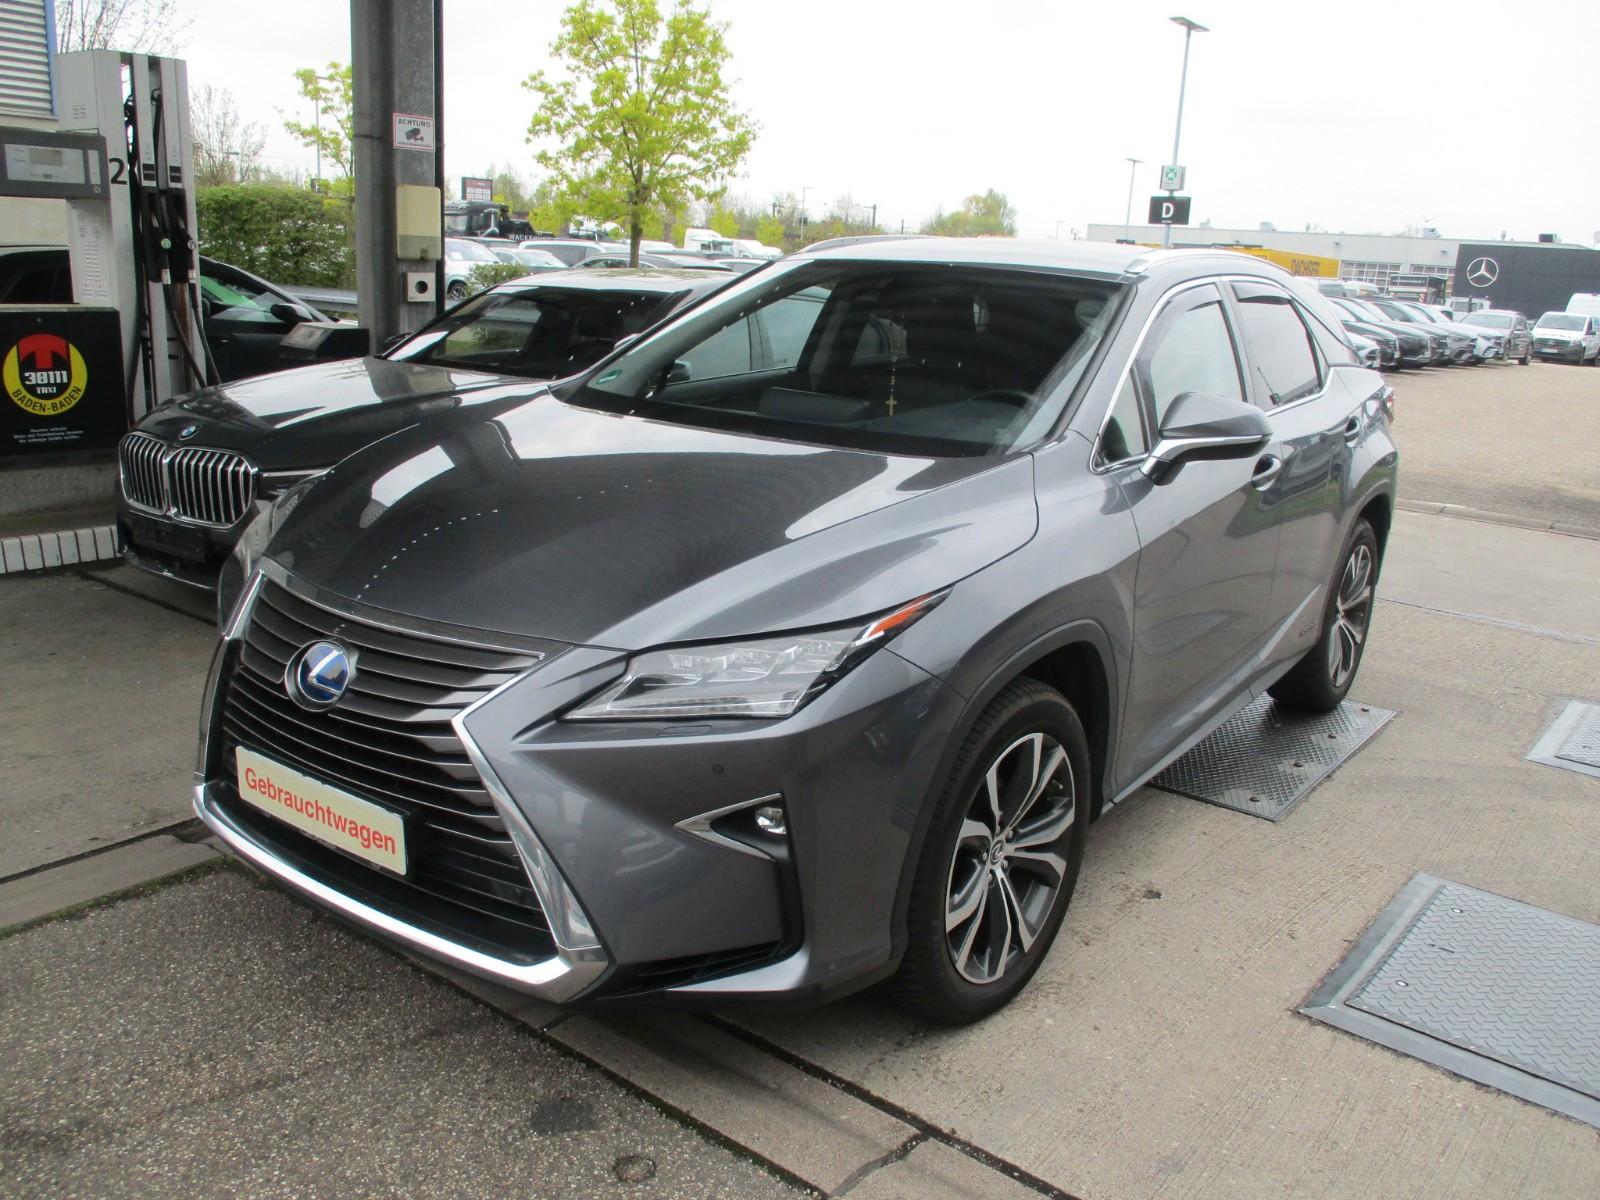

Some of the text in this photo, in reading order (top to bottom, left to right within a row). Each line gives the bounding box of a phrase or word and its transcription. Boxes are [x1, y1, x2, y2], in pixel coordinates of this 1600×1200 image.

[397, 117, 432, 128] ACHTUNG
[108, 157, 128, 186] 2
[1161, 202, 1174, 219] D
[24, 370, 68, 385] 38111
[36, 386, 57, 394] TAXI
[12, 386, 82, 413] BADEN-BADEN
[244, 767, 396, 855] Gebrauchtwagen
